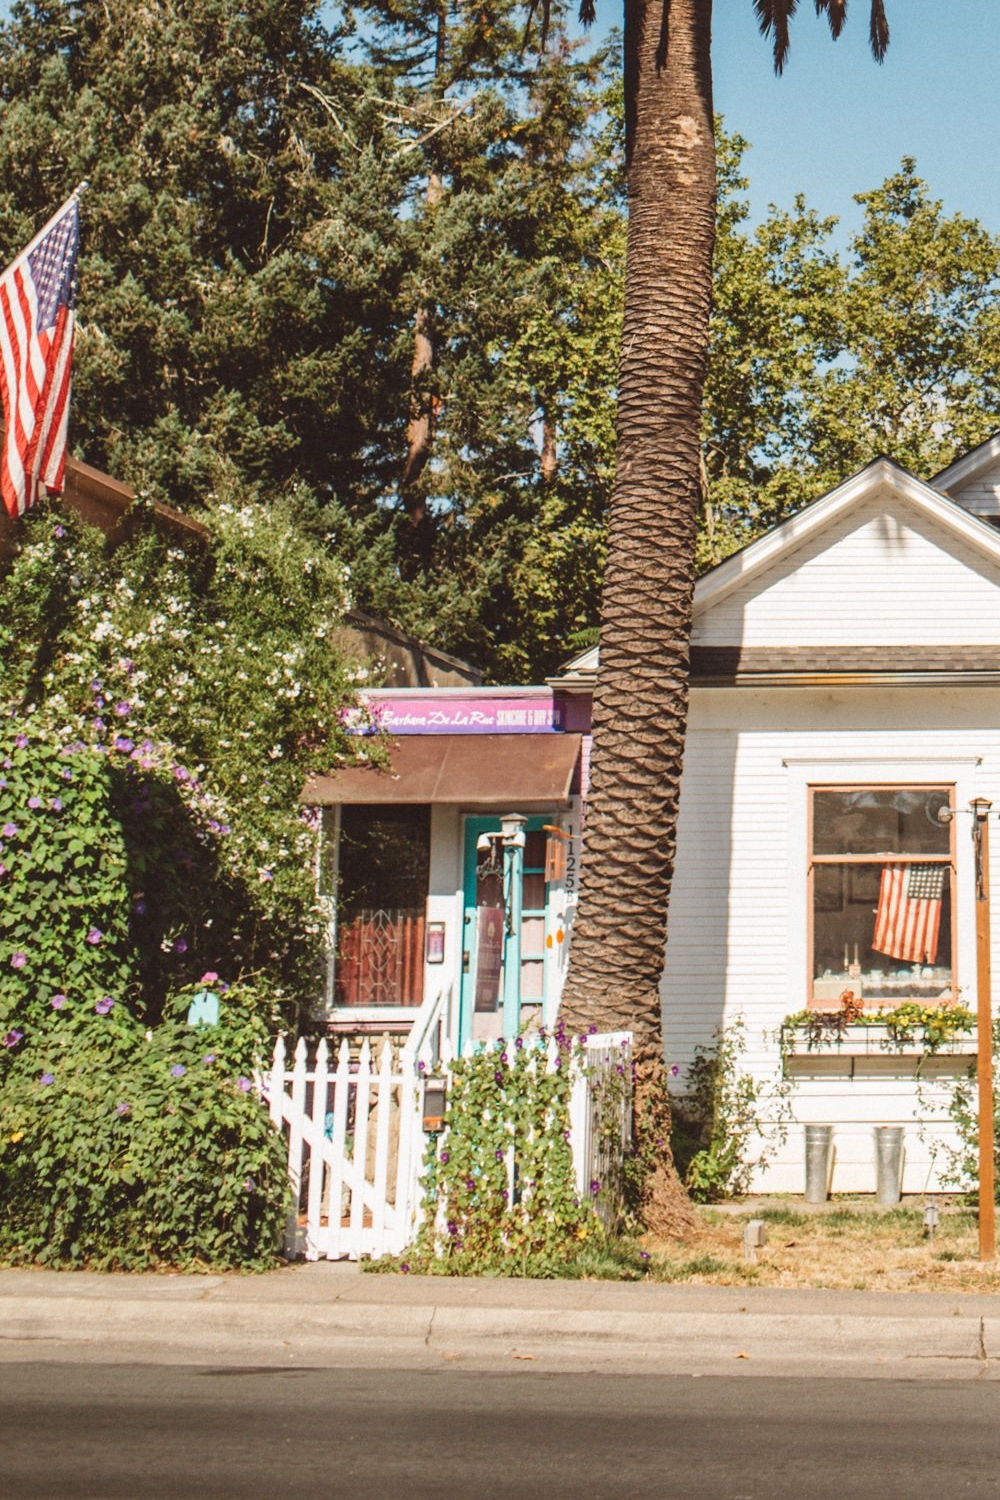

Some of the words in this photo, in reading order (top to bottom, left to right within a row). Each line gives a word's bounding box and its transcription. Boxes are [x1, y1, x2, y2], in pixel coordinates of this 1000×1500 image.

[382, 710, 427, 726] Barbara
[427, 710, 450, 725] De
[450, 710, 468, 726] La
[469, 710, 495, 725] Rue
